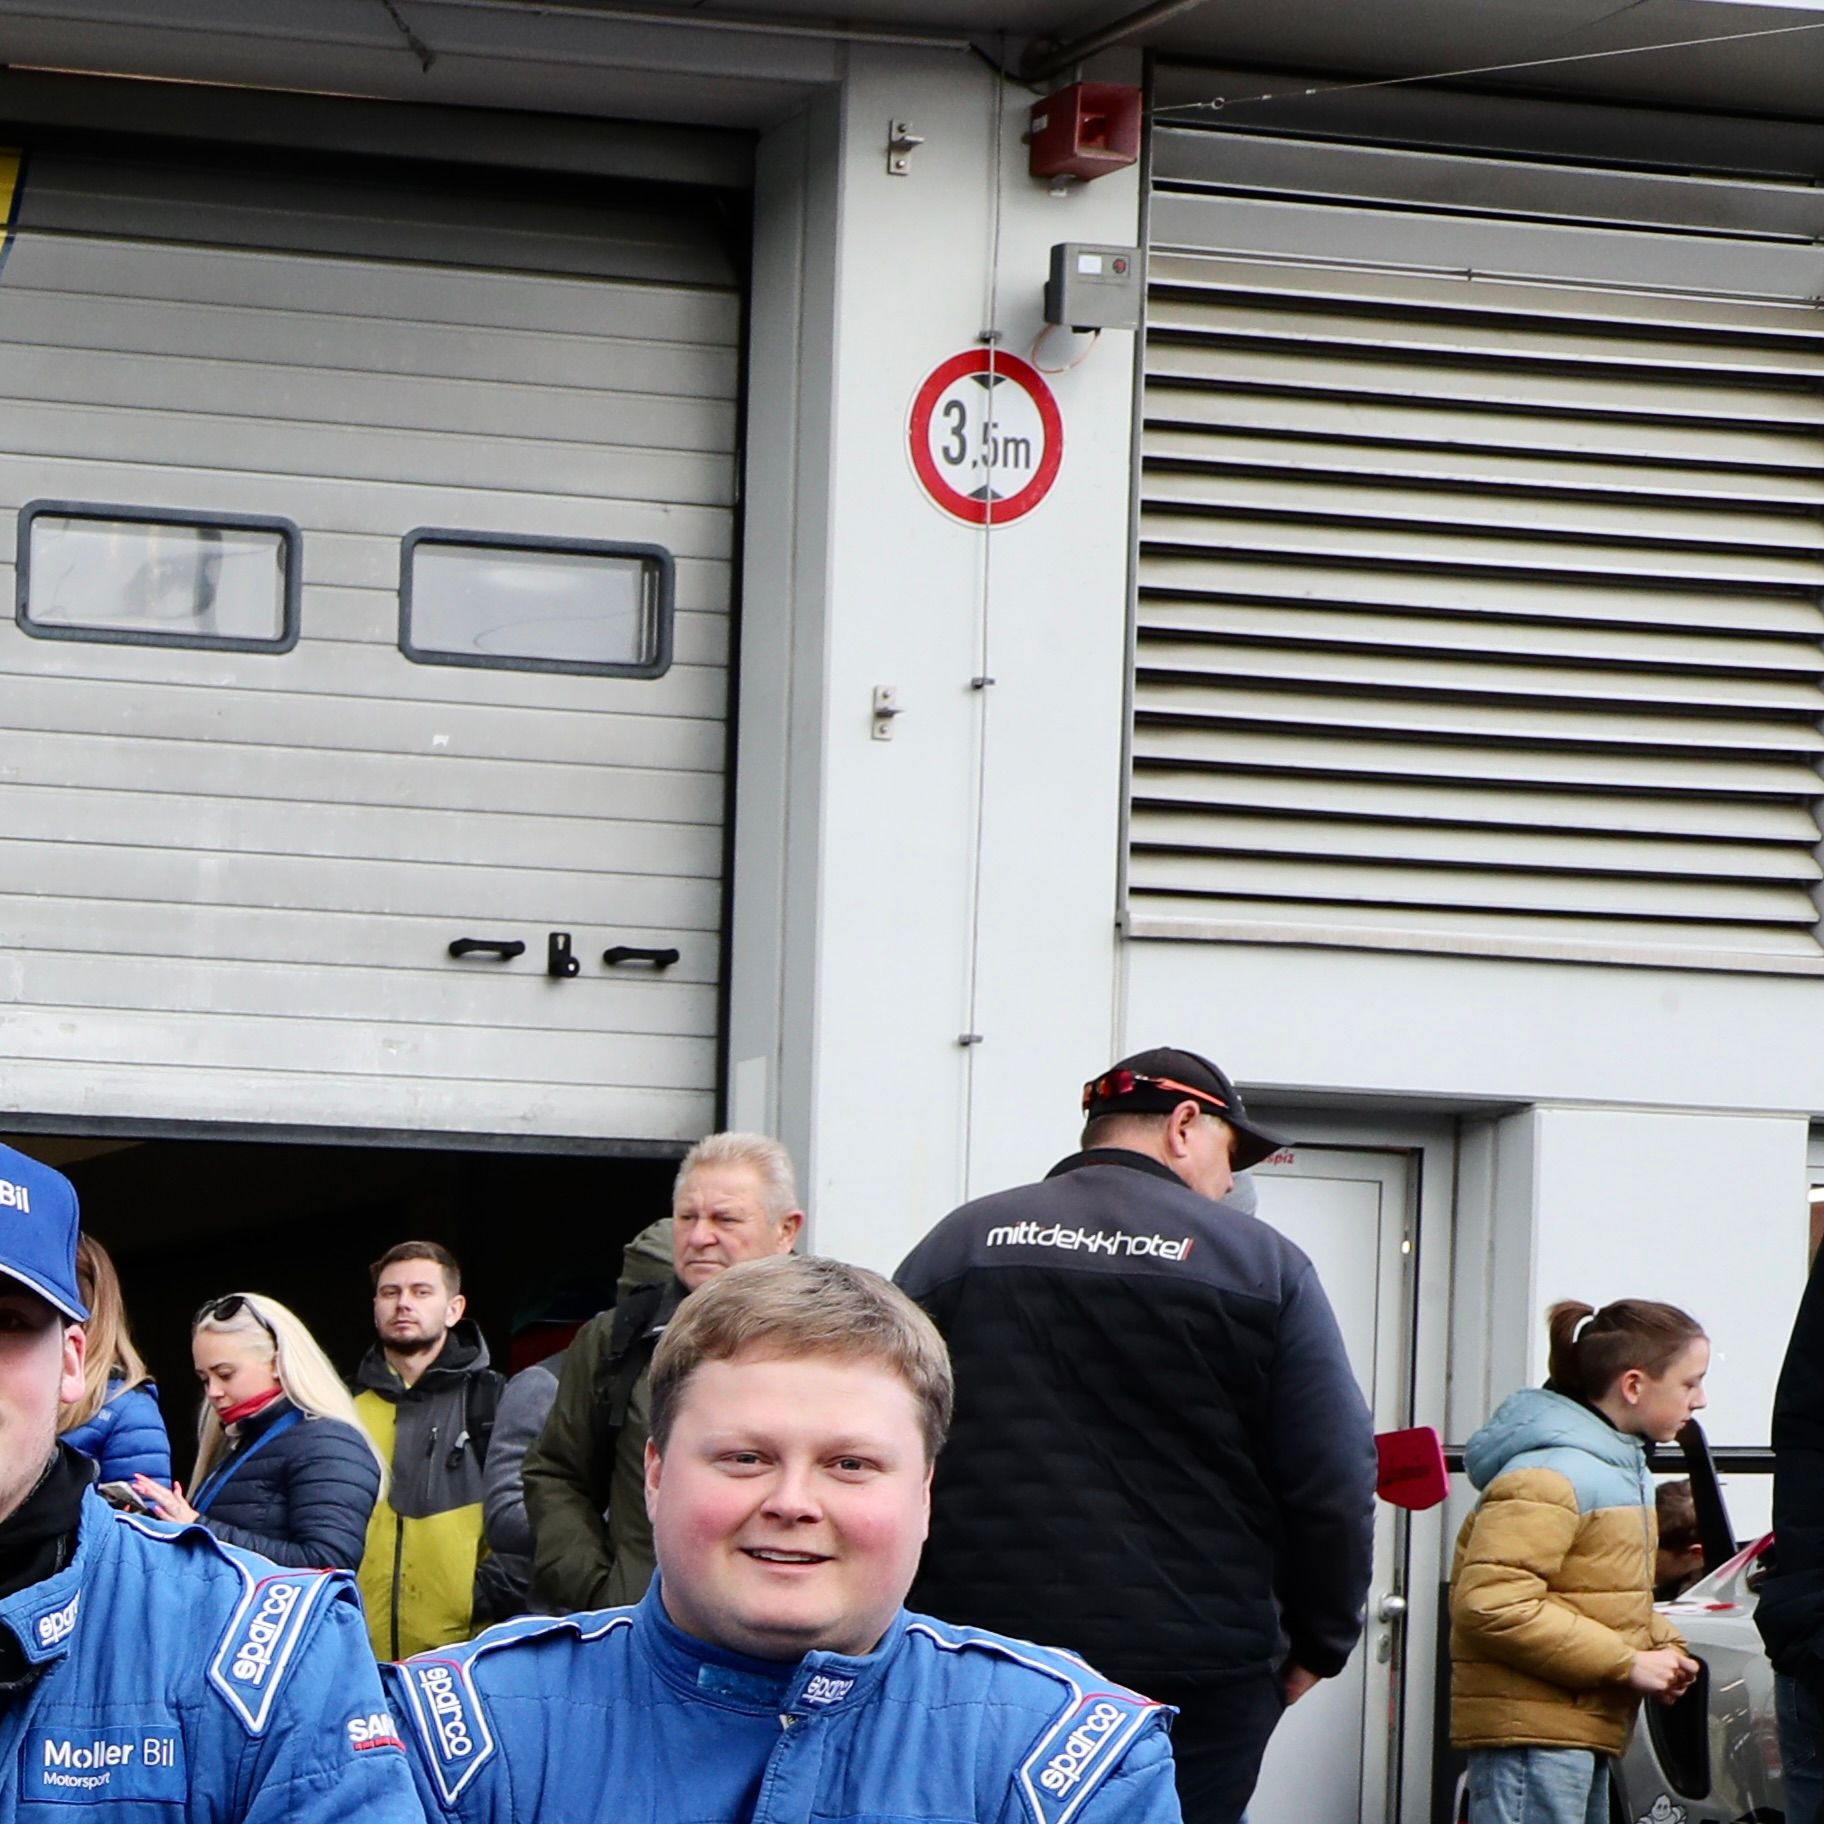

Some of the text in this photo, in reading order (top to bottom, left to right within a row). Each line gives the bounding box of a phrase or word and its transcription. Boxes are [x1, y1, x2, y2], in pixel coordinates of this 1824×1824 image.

[941, 399, 1031, 471] 3,5m
[143, 1737, 174, 1768] Bil
[1040, 1702, 1128, 1799] sparco
[43, 1771, 111, 1790] Motorsport
